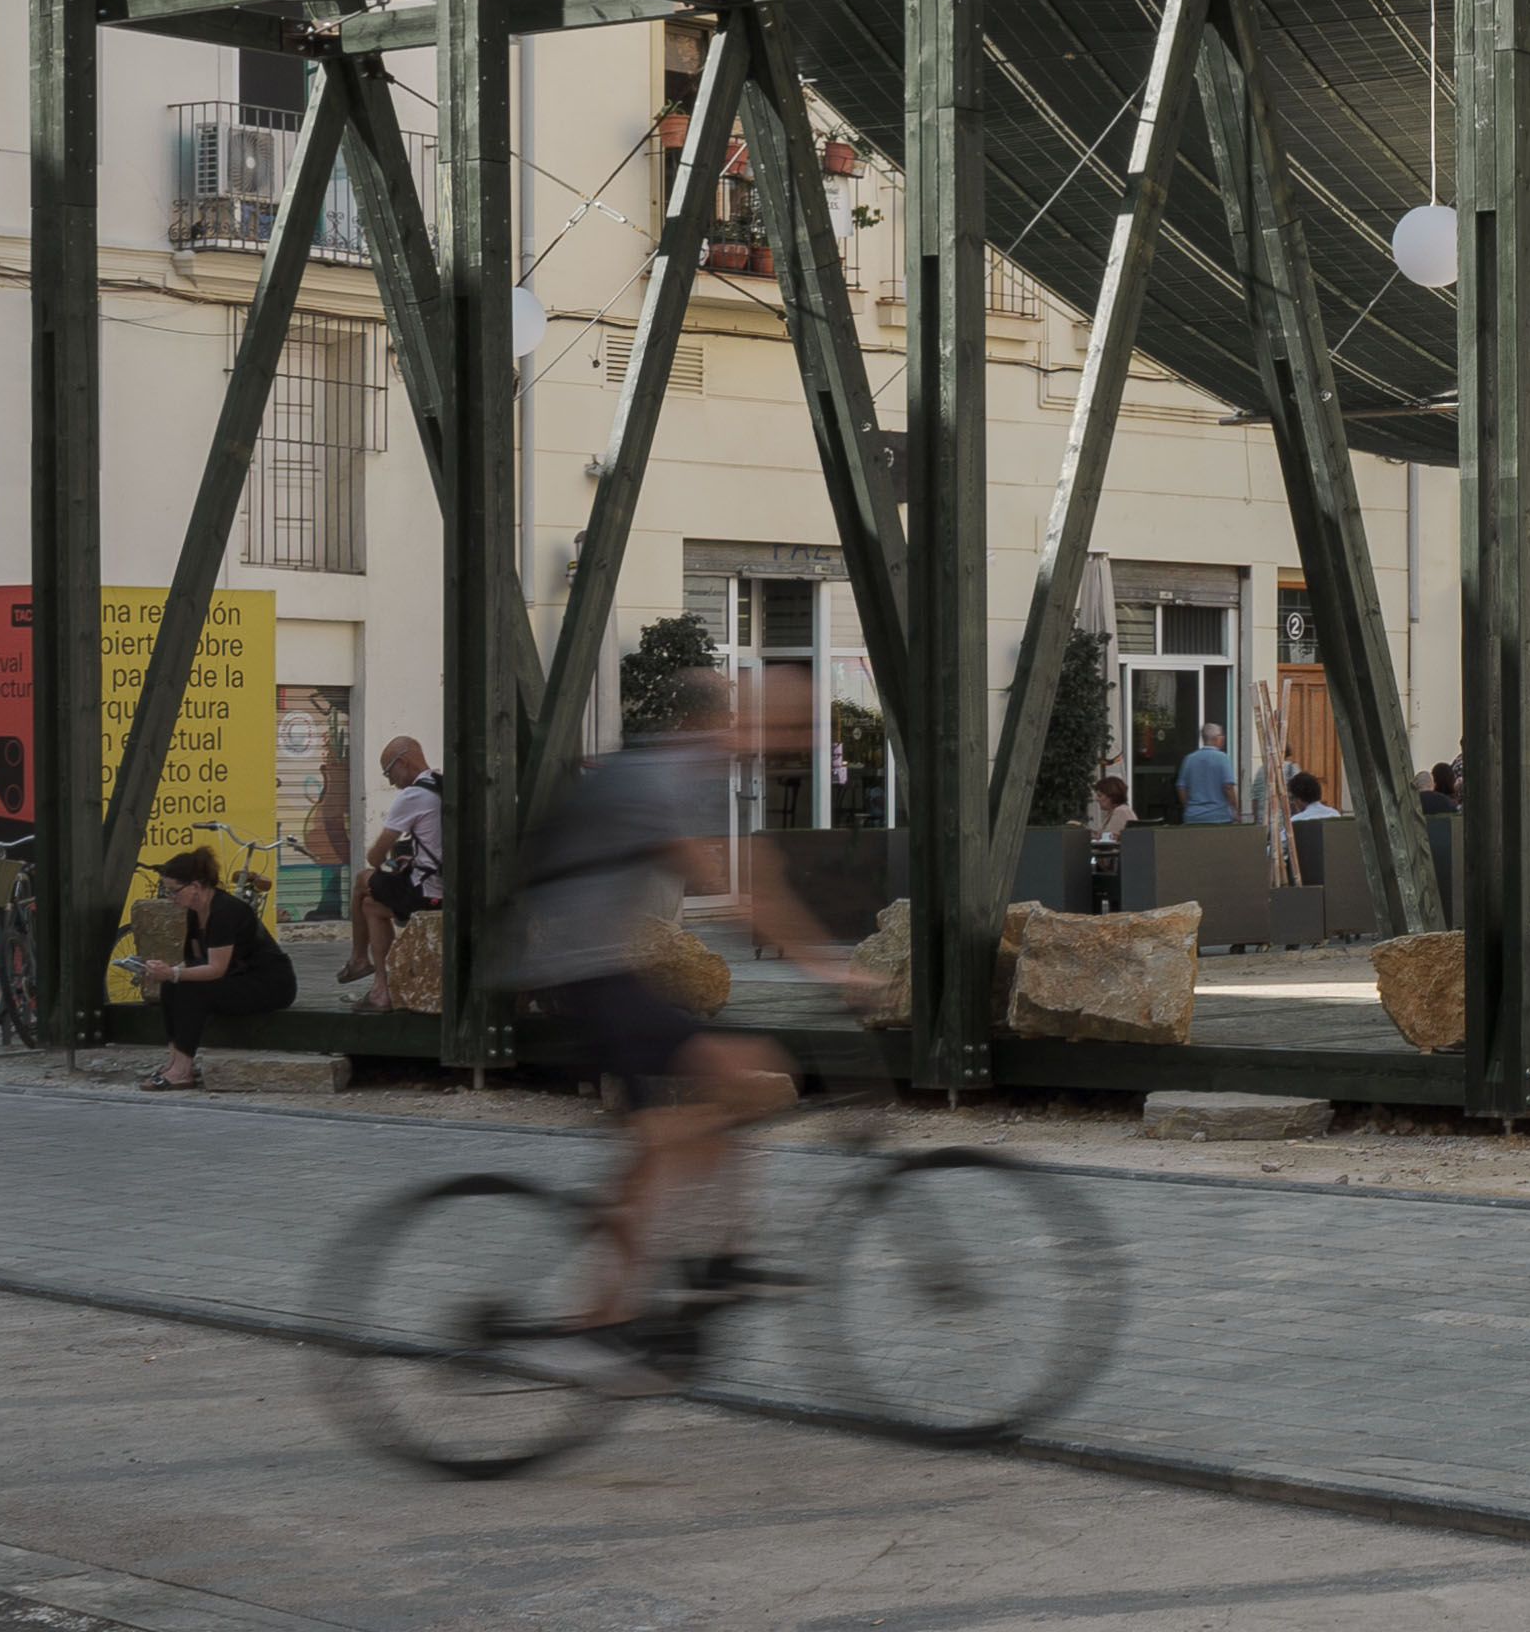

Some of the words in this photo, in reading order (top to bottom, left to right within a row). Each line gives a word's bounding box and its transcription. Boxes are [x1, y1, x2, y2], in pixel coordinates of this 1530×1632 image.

[189, 664, 218, 689] de
[225, 664, 244, 689] la
[198, 758, 229, 783] de
